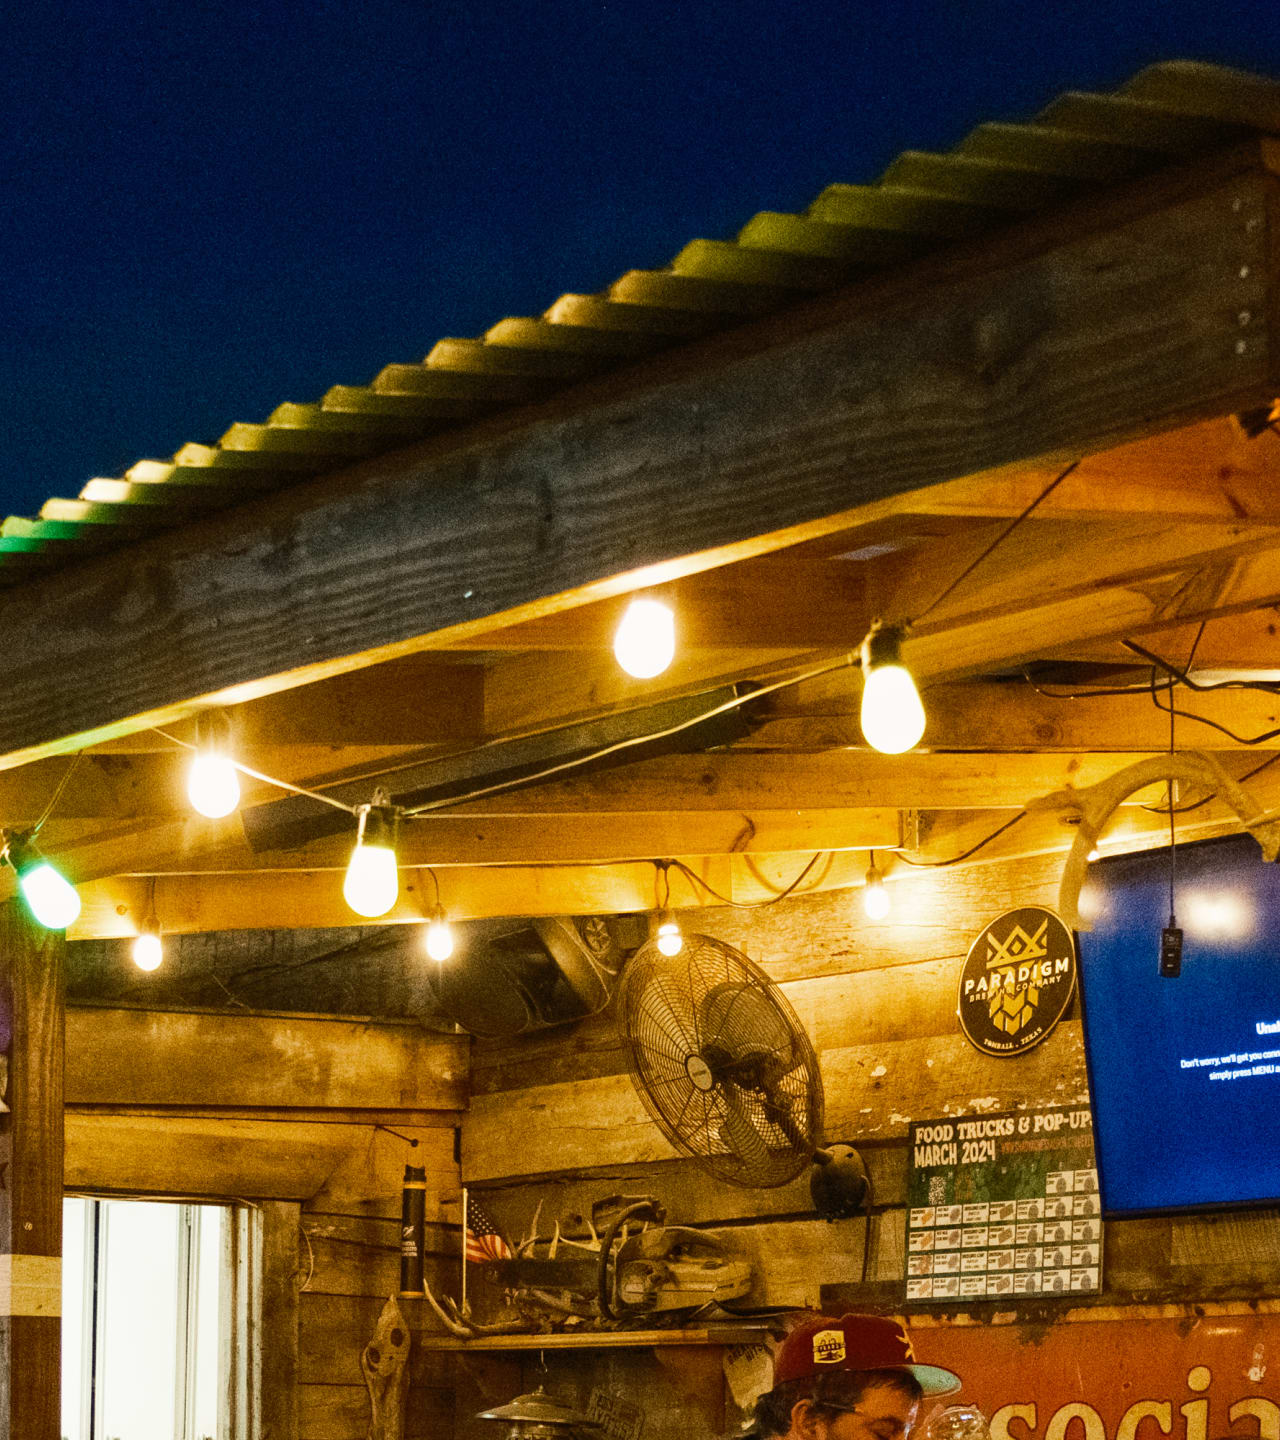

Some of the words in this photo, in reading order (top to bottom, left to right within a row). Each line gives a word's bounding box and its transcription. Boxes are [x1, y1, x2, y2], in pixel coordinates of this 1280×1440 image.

[964, 957, 1069, 995] PARADIGM
[1016, 975, 1062, 992] COMPANY
[1020, 1026, 1043, 1045] TEXAS
[915, 1123, 954, 1145] FOOD
[956, 1118, 1015, 1141] TRUCKS
[1017, 1115, 1030, 1134] &
[914, 1143, 958, 1169] MARCH
[961, 1139, 996, 1164] 2024
